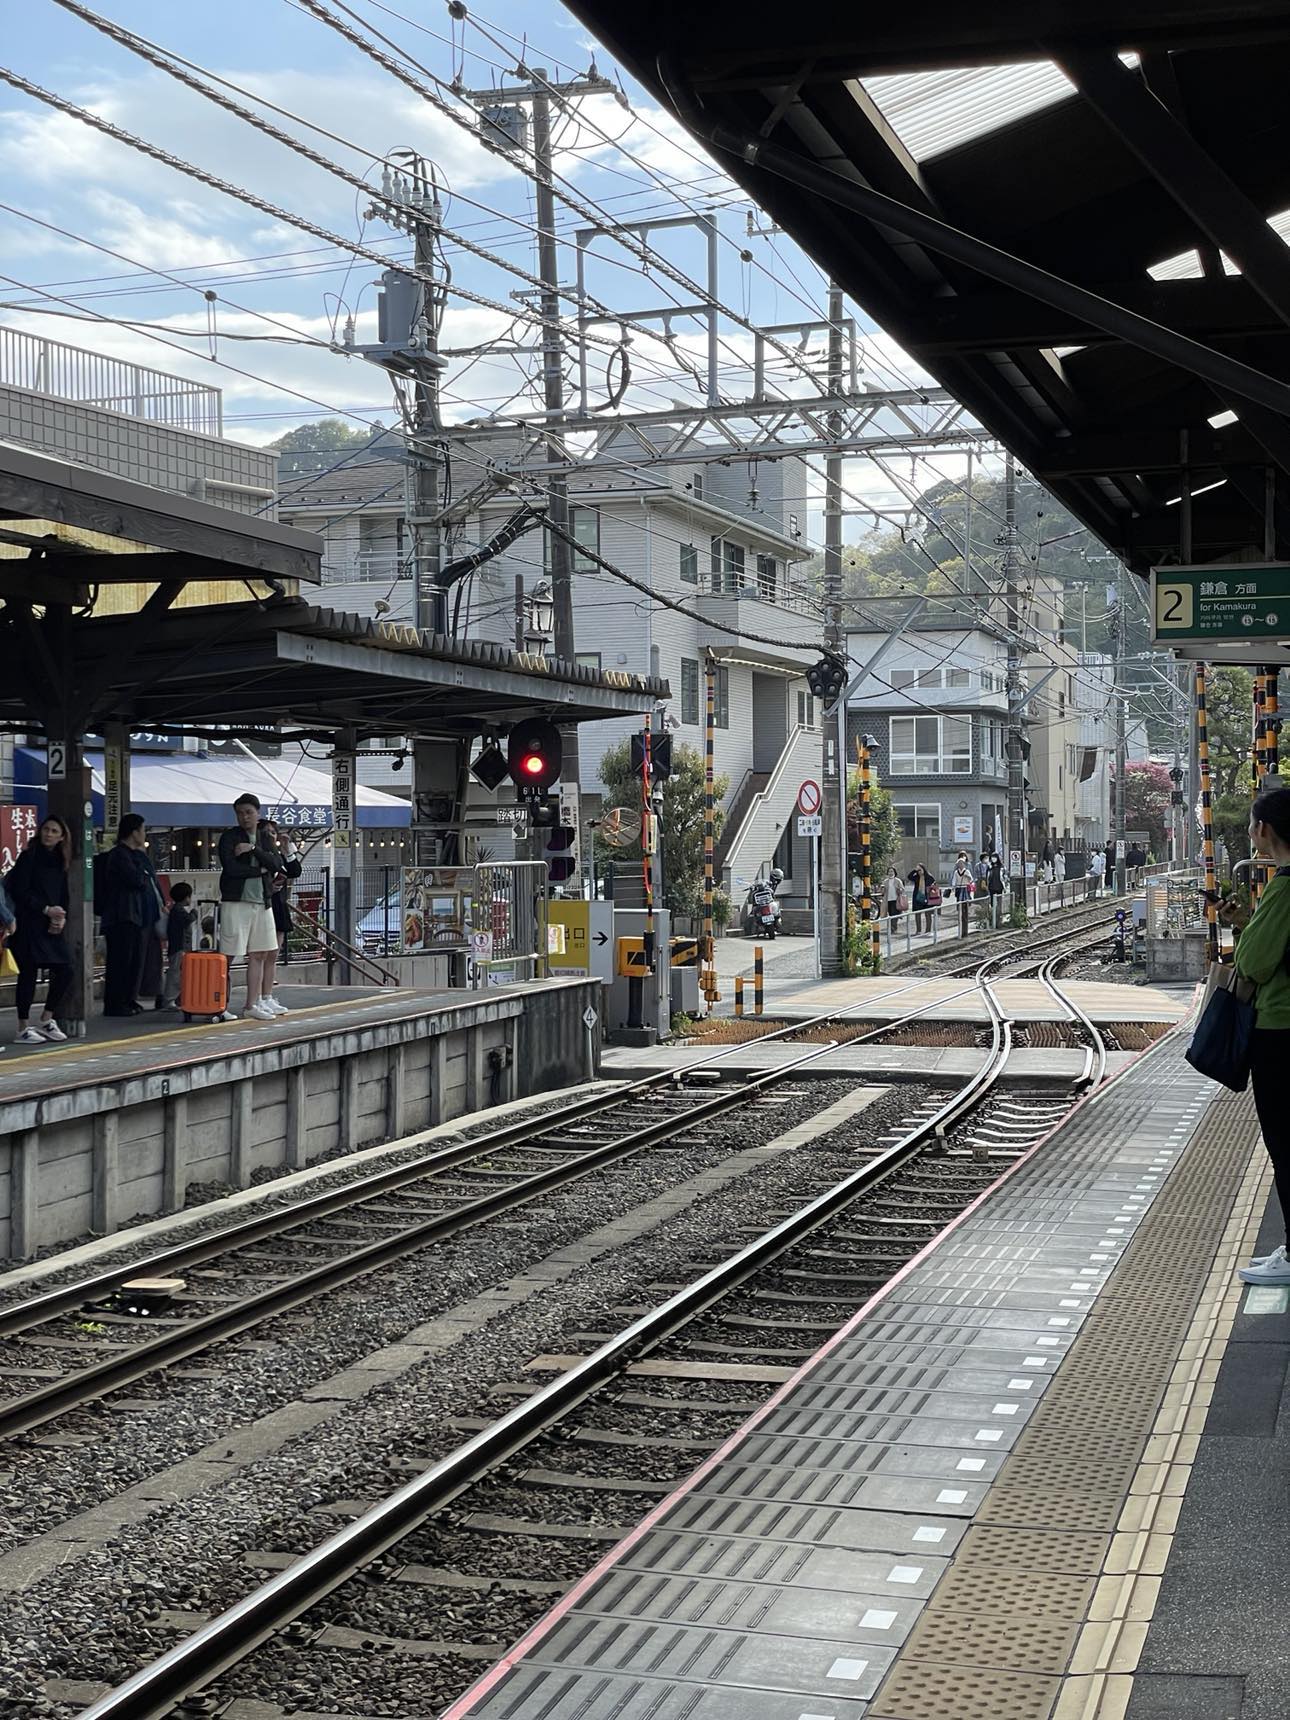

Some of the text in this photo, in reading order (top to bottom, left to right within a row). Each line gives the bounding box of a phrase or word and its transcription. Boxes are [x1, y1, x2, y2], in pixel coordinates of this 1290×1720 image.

[1200, 581, 1257, 596] 鎌倉 方面
[1163, 590, 1183, 622] 2
[1200, 602, 1257, 612] for Kamakura
[50, 748, 64, 775] 2
[108, 781, 118, 828] 足元注意
[335, 759, 350, 829] 右側通行
[498, 808, 527, 822] 踏切
[586, 1008, 594, 1024] 4
